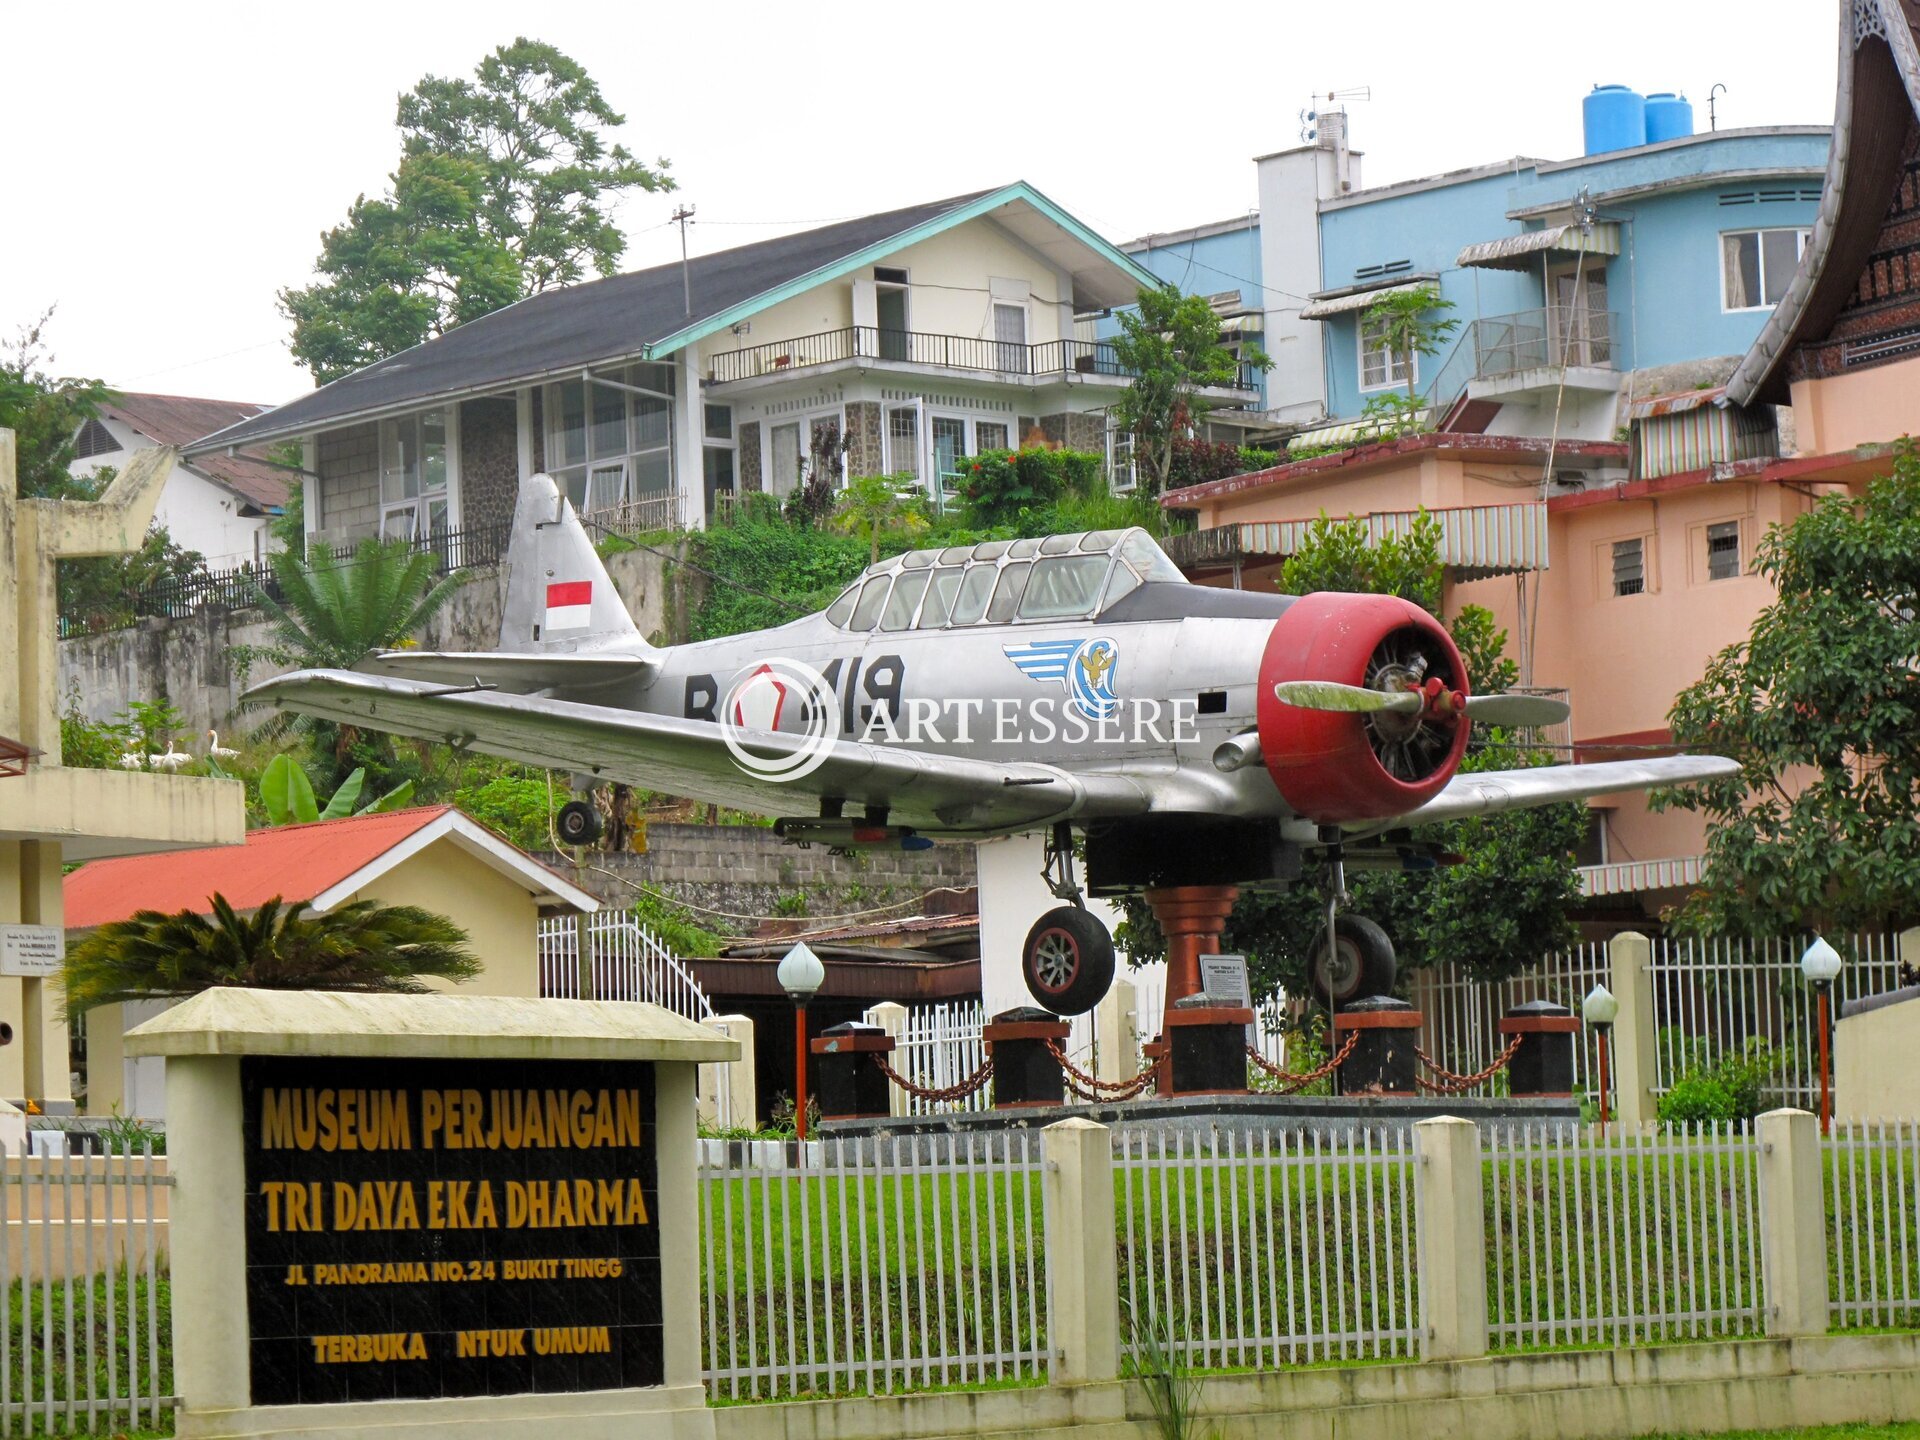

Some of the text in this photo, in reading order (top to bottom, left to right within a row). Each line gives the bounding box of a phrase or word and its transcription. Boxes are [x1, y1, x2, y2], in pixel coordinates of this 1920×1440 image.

[261, 1087, 640, 1151] MUSEUM PERJUANGAN
[260, 1178, 649, 1231] TRI DAYA EKA DHARMA
[314, 1262, 429, 1285] PANORAMA
[432, 1261, 496, 1281] NO.24
[503, 1259, 559, 1280] BUKIT
[562, 1258, 623, 1279] TINGG
[312, 1326, 611, 1363] TERBUKA NTUK UMUM
